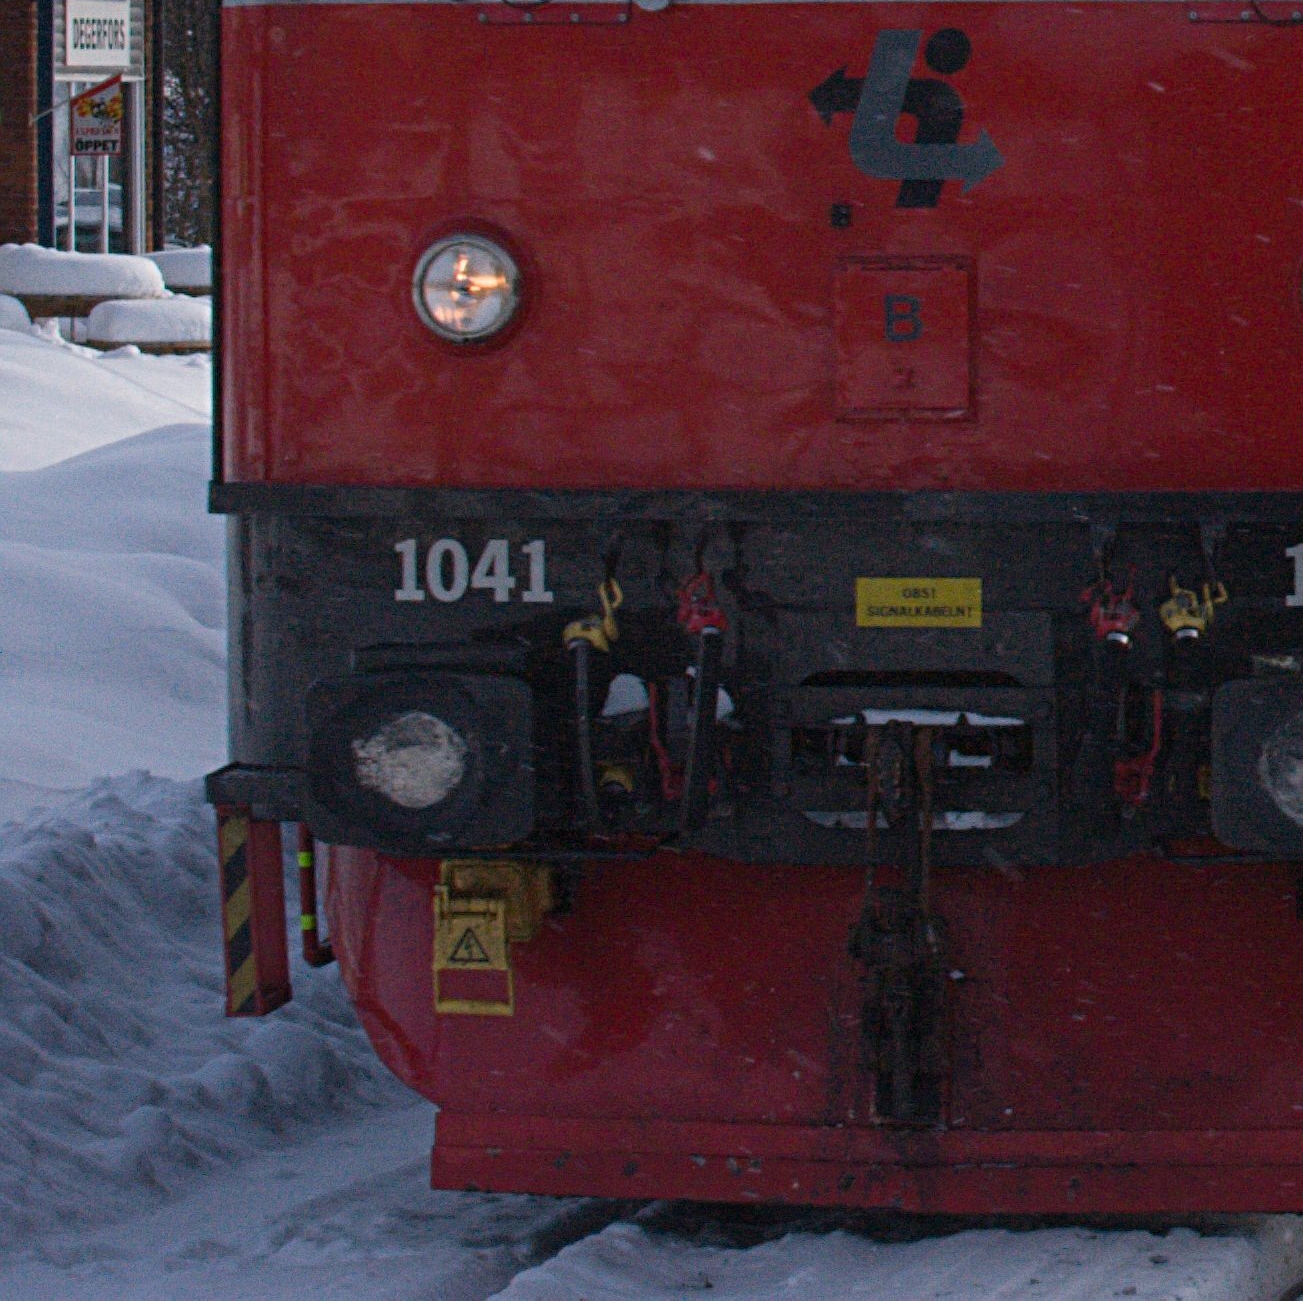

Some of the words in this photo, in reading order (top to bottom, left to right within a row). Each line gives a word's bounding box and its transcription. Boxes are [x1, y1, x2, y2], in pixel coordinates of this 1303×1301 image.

[73, 18, 125, 50] DEGERFORS
[75, 137, 119, 151] ÖPPET
[884, 294, 923, 342] B
[393, 538, 554, 603] 1041
